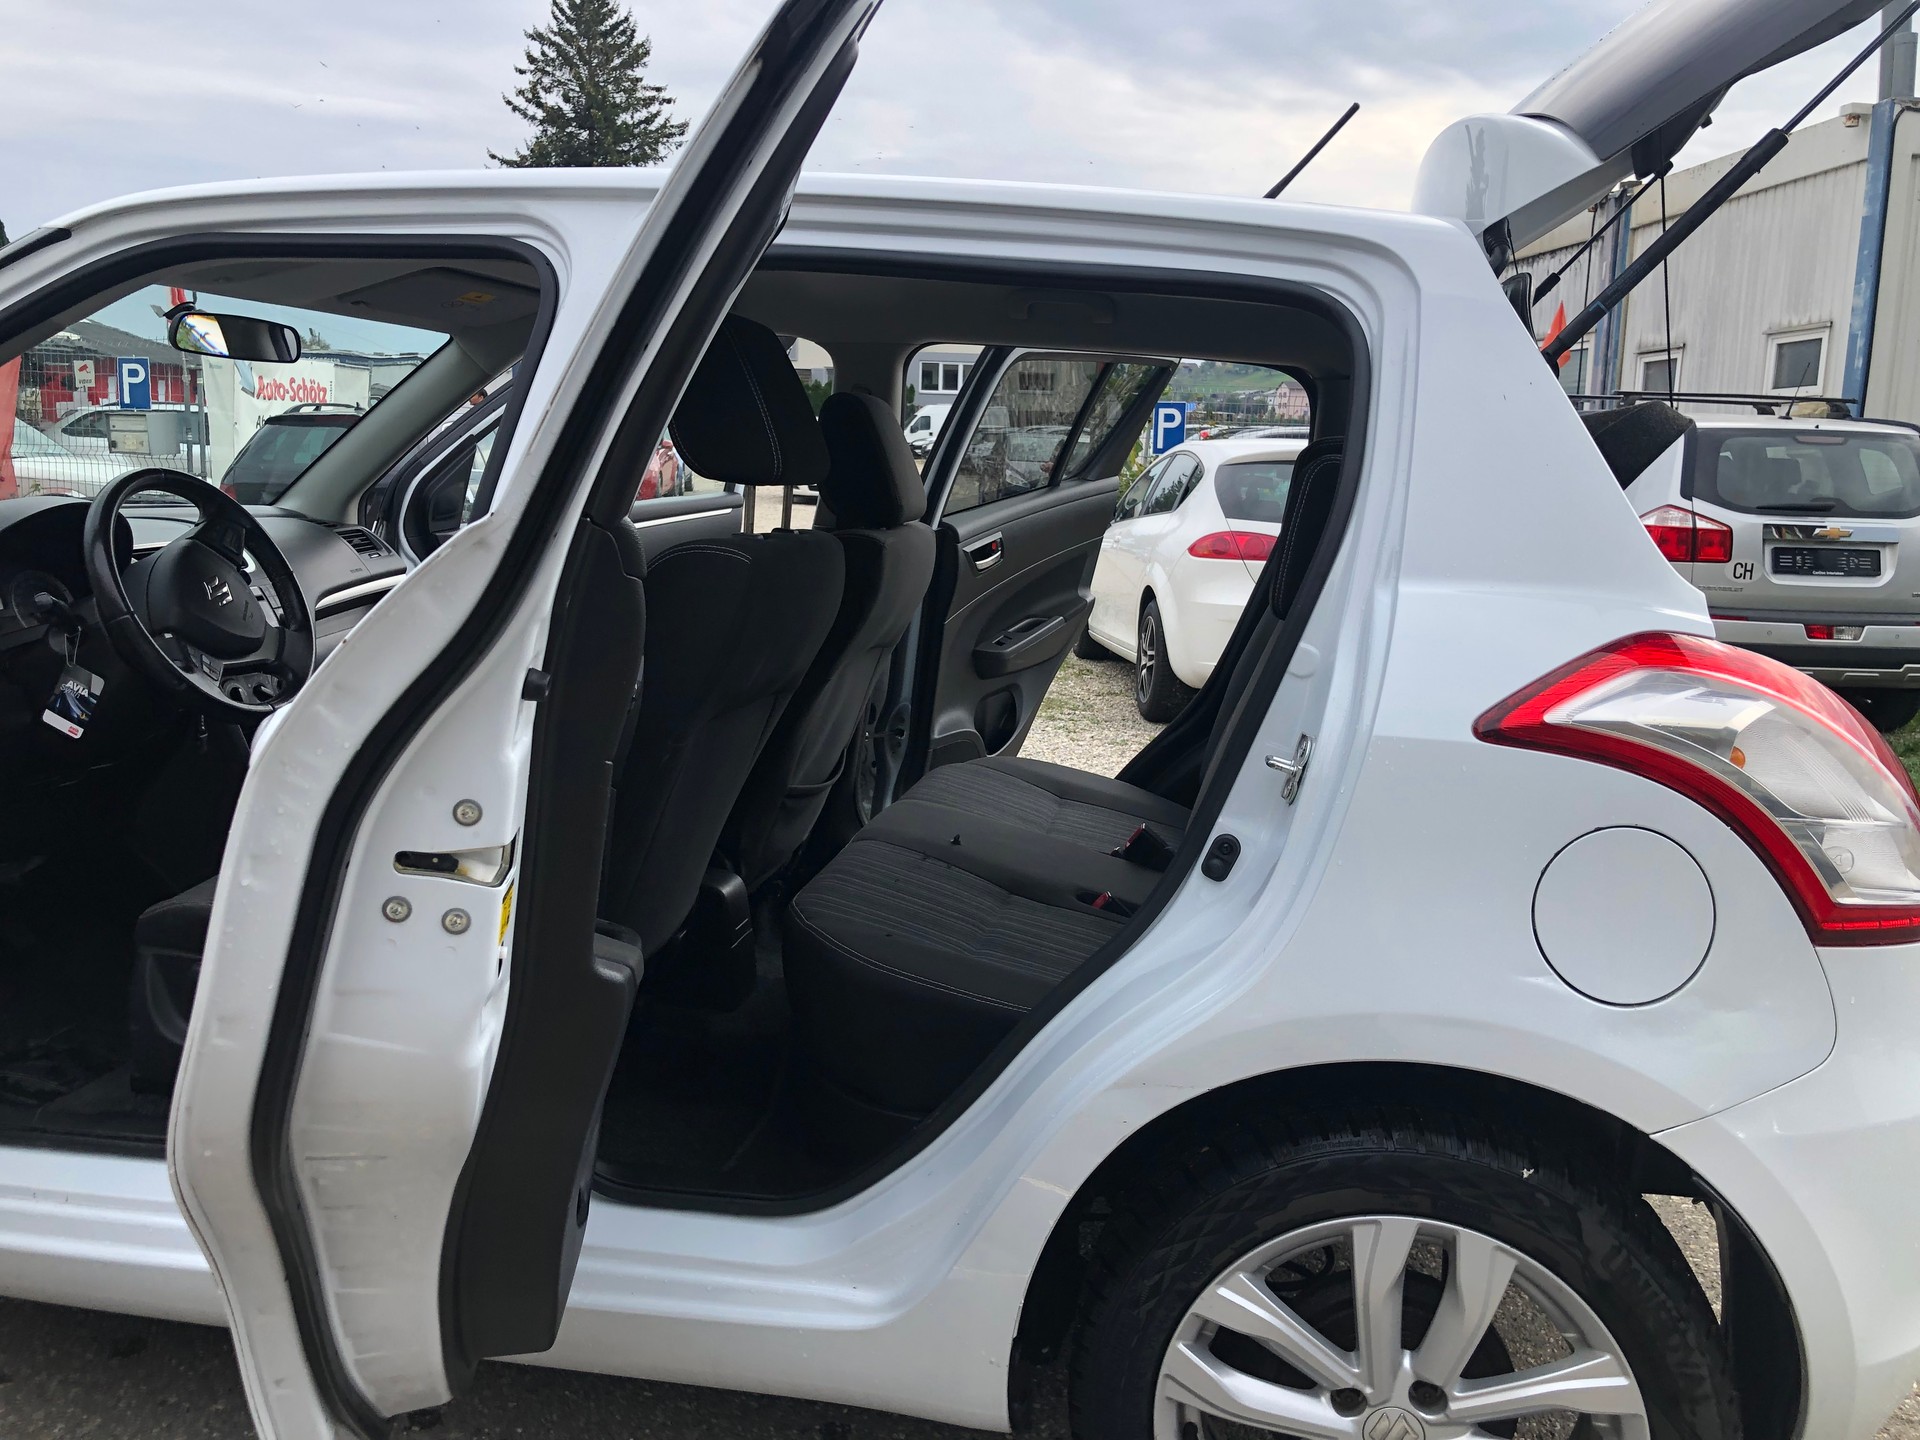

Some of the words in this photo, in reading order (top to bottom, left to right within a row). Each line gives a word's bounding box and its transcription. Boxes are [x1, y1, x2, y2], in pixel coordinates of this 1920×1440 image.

[122, 363, 146, 404] P
[256, 375, 328, 403] Auto-Schötz
[1157, 407, 1182, 449] P
[1732, 562, 1754, 580] CH
[66, 680, 89, 697] AVIA
